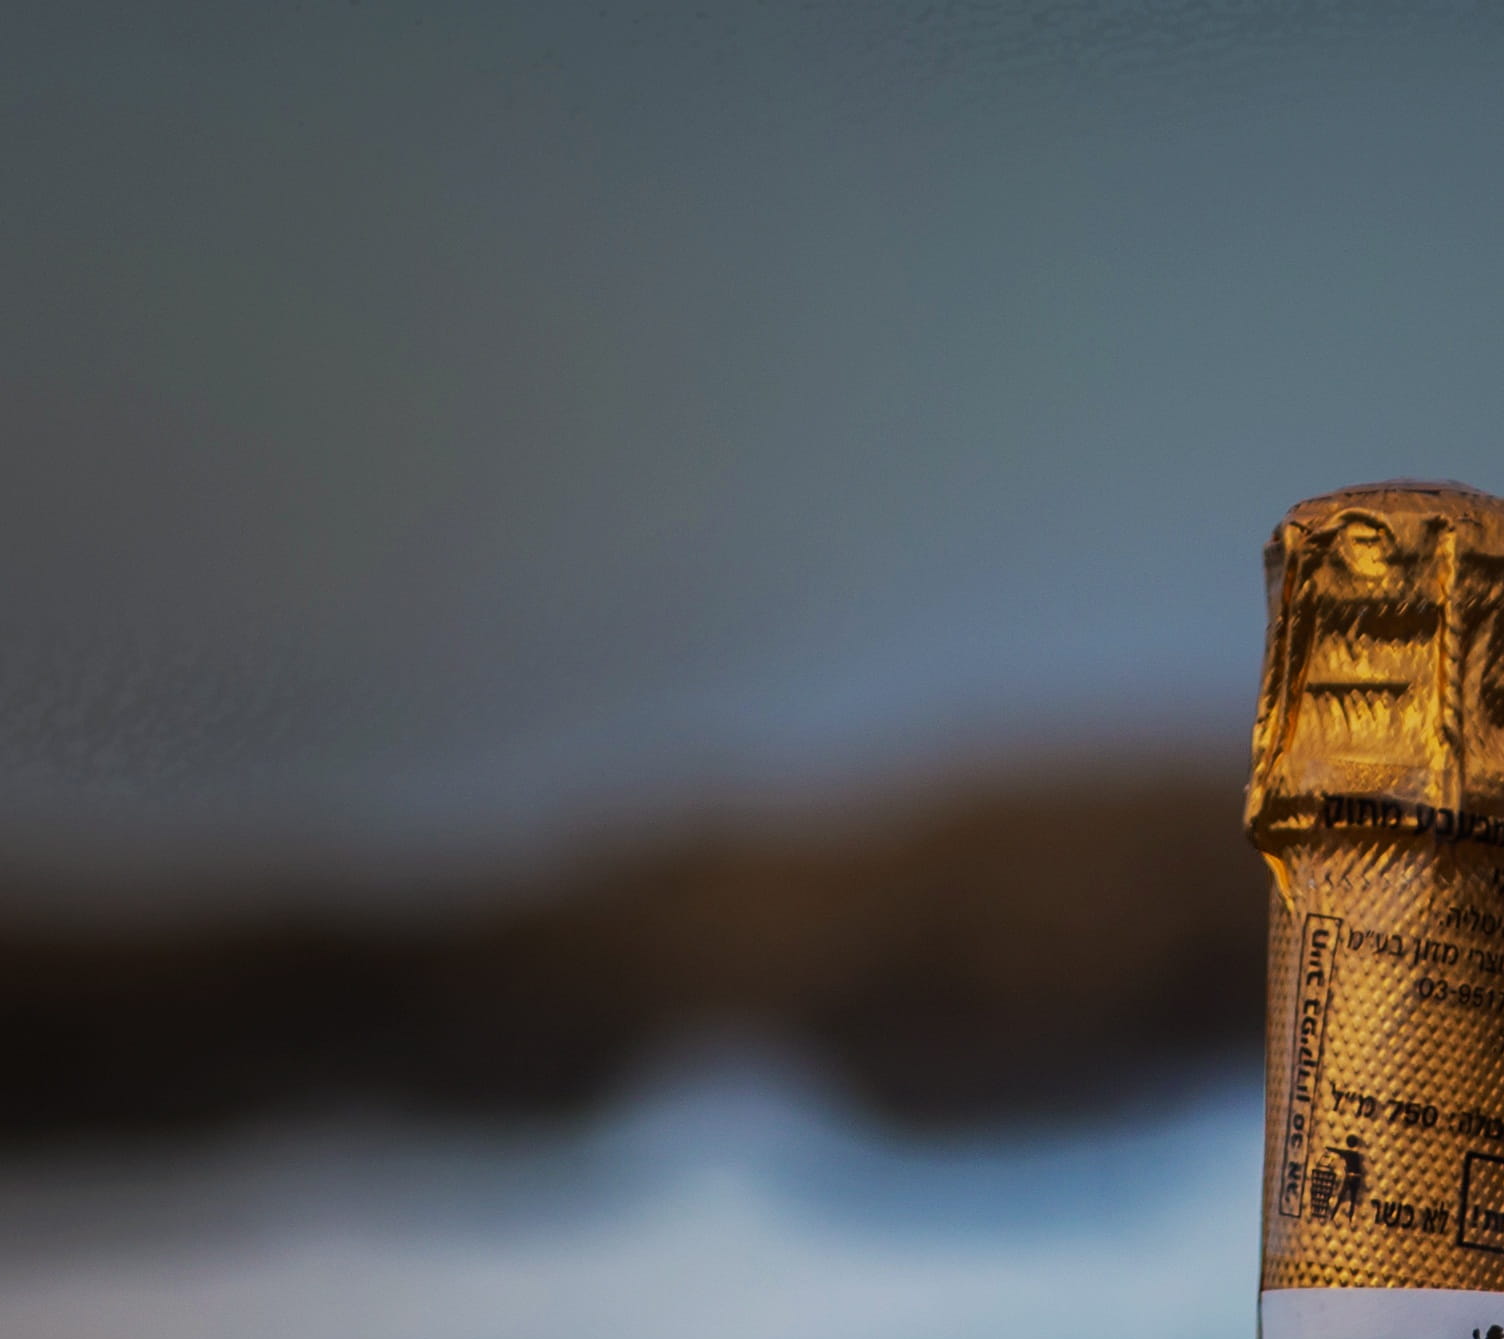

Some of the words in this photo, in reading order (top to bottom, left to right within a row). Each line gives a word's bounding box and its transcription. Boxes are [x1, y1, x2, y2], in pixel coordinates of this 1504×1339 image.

[1305, 928, 1330, 987] חייב
[1413, 935, 1460, 967] מזון
[1295, 998, 1322, 1103] בפיקדון
[1387, 1099, 1439, 1127] 750
[1371, 1198, 1415, 1229] כשר
[1422, 1200, 1450, 1235] לא
